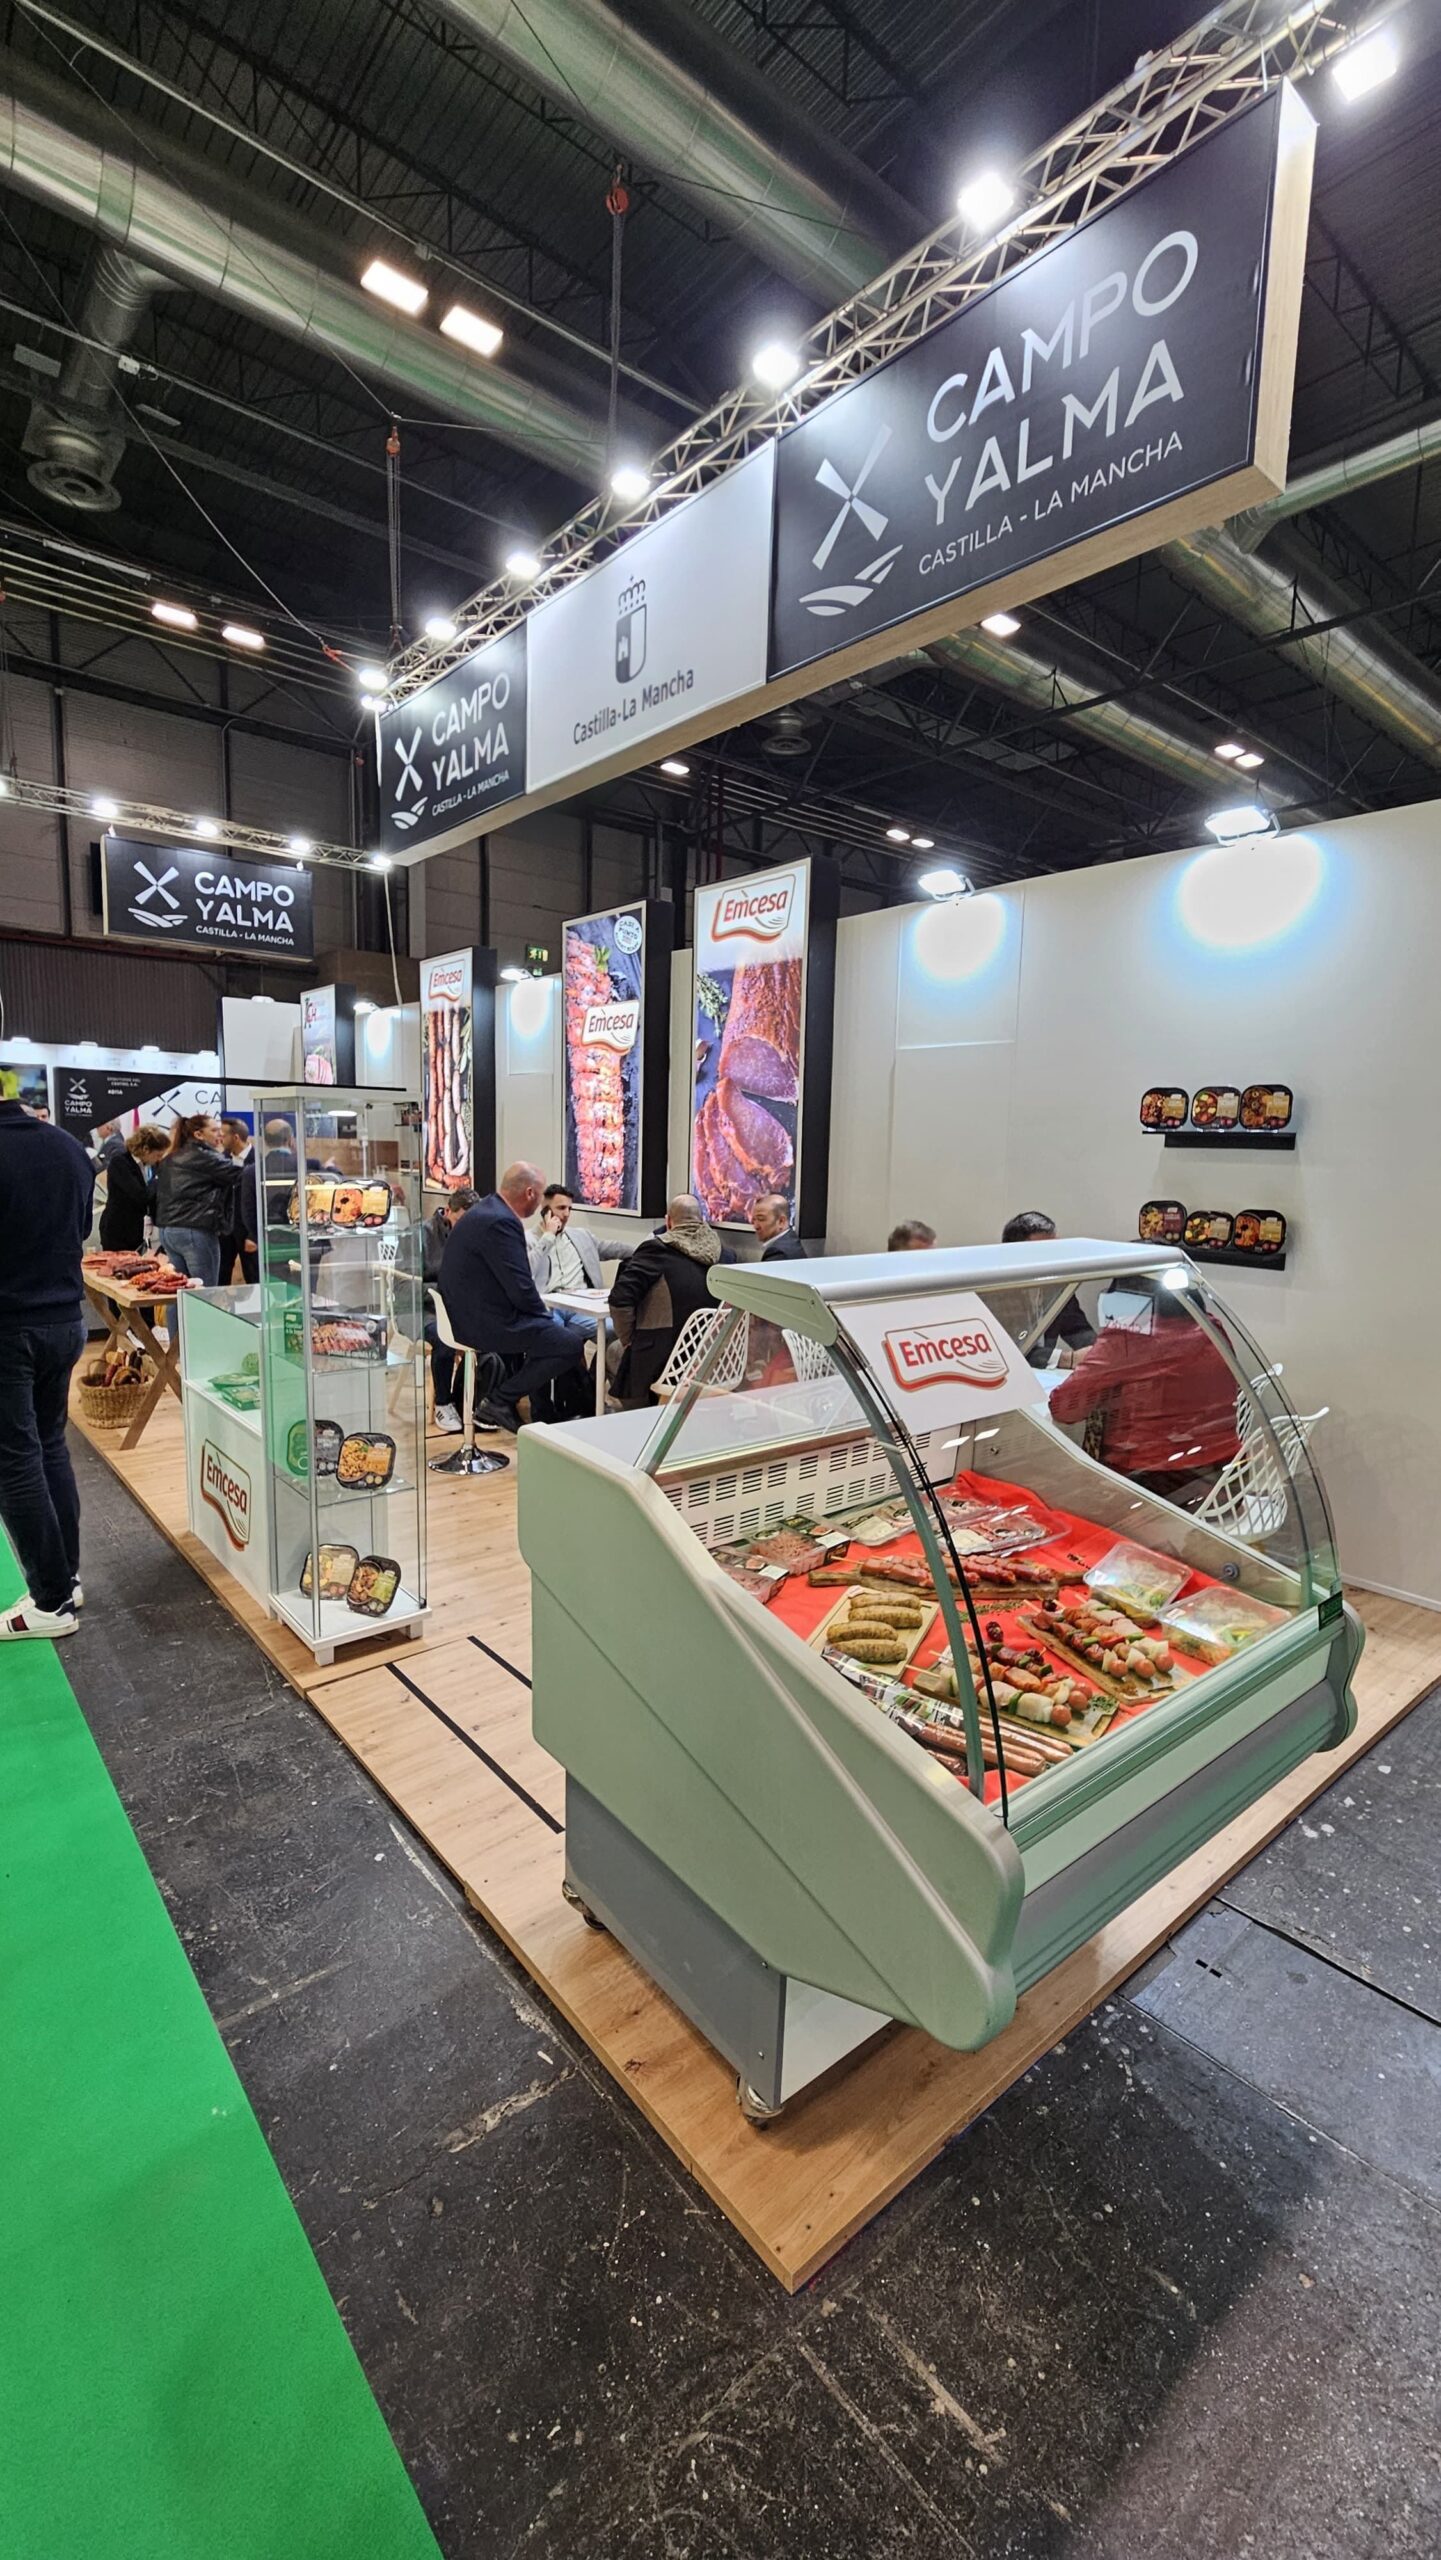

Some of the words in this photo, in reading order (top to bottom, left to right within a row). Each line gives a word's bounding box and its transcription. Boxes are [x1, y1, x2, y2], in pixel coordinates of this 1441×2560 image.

[926, 230, 1198, 443] CAMPO
[925, 339, 1184, 525] YALMA
[919, 515, 1013, 575] CASTILLA
[1034, 491, 1063, 521] LA
[1071, 431, 1183, 504] MANCHA
[642, 668, 695, 712] Mancha
[432, 671, 510, 747] CAMPO
[432, 723, 509, 791] YALMA
[432, 792, 463, 817] CASTILLA
[467, 786, 477, 801] LA
[477, 769, 510, 796] MANCHA
[194, 871, 295, 907] CAMPO
[723, 889, 789, 923] Emcesa
[195, 898, 294, 933] YALMA
[195, 925, 238, 939] CASTILLA
[244, 931, 257, 941] LA
[258, 934, 294, 946] MANCHA
[432, 968, 463, 988] Emcesa
[588, 1009, 634, 1034] Emcesa
[64, 1099, 93, 1108] CAMPO
[64, 1106, 93, 1114] YALMA
[899, 1333, 992, 1367] Emcesa
[207, 1454, 248, 1516] Emcesa
